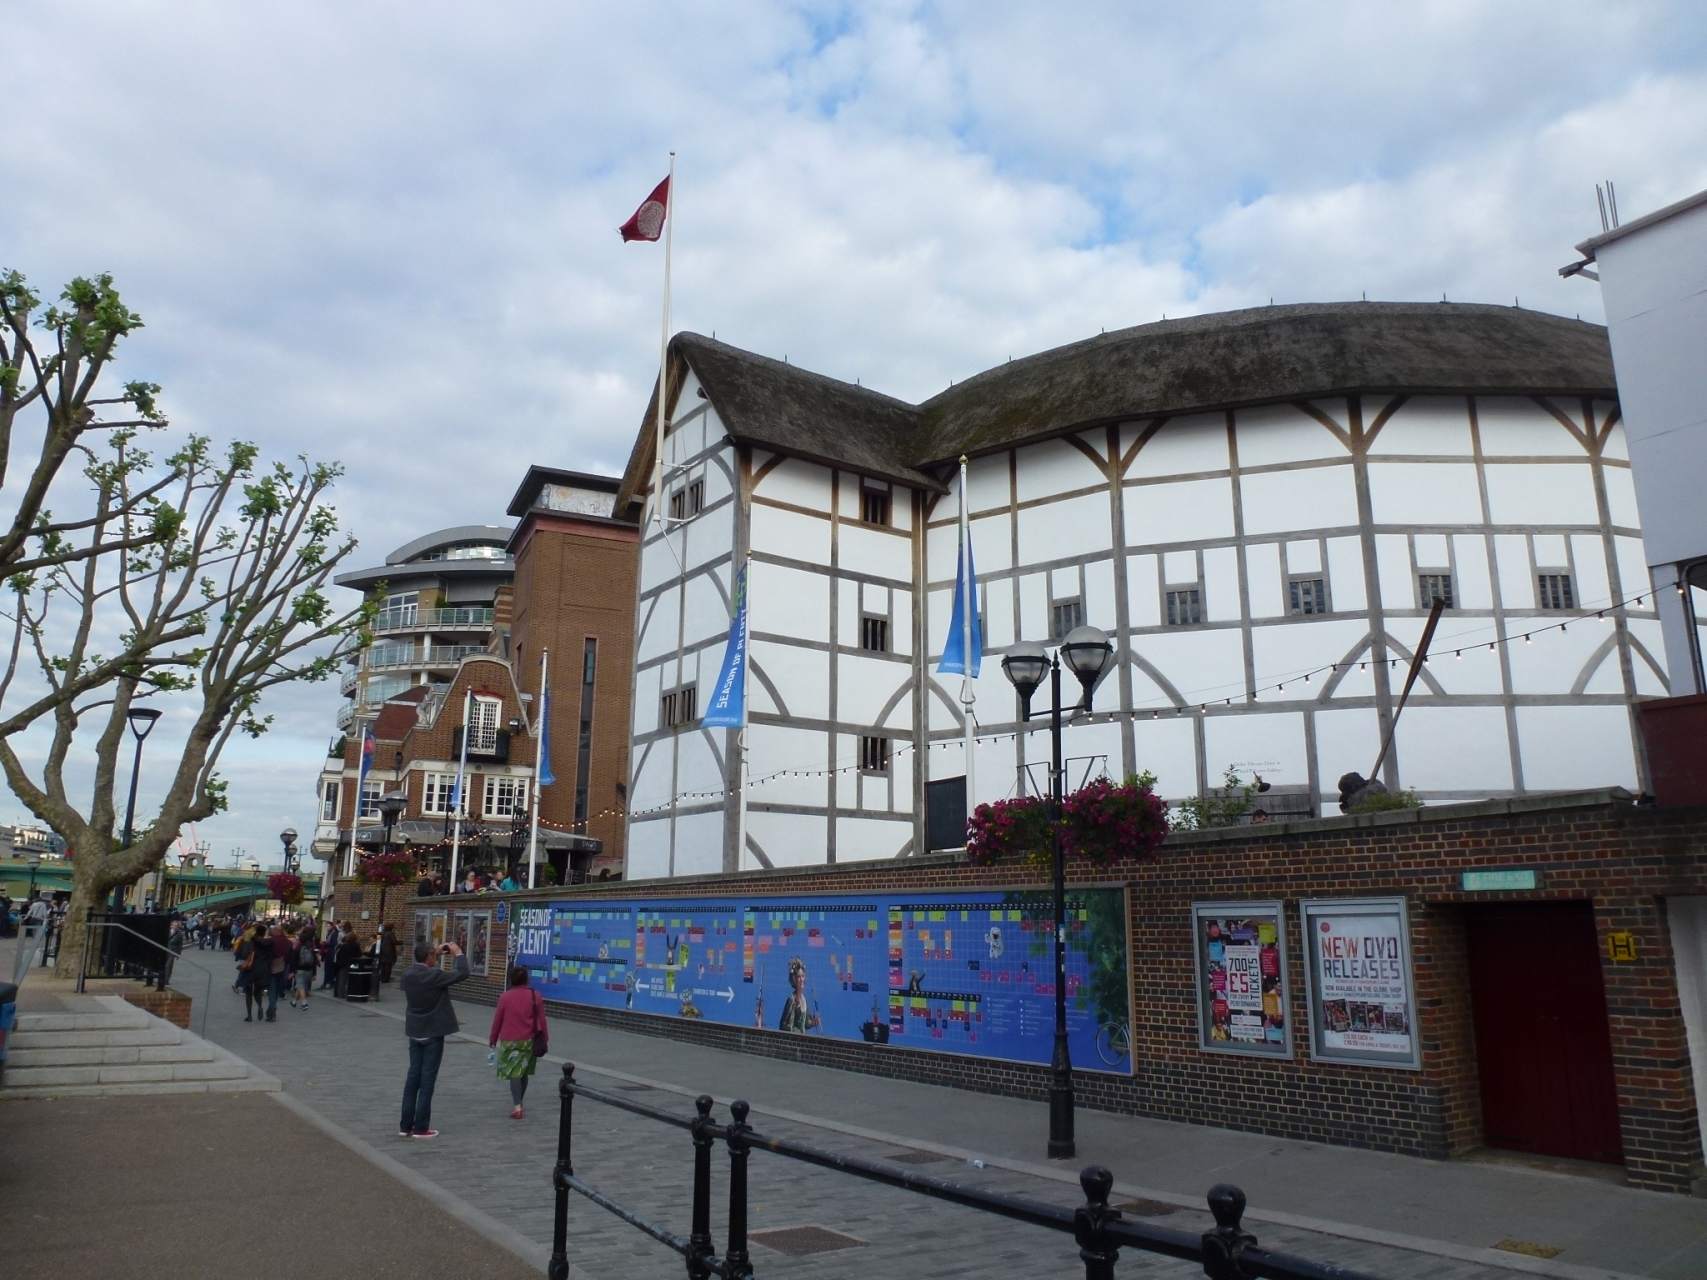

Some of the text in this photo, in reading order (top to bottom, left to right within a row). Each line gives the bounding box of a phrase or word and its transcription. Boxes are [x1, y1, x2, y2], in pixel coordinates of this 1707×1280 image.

[716, 667, 738, 709] SEASON
[732, 652, 742, 666] OF
[520, 908, 543, 926] SEASON
[544, 908, 552, 926] OF
[518, 929, 551, 955] PLENTY
[1322, 936, 1398, 958] NEW DVD
[1229, 957, 1248, 972] 700
[1323, 959, 1400, 979] RELEASES
[1229, 973, 1249, 993] £5
[1248, 958, 1260, 1000] TICKETS
